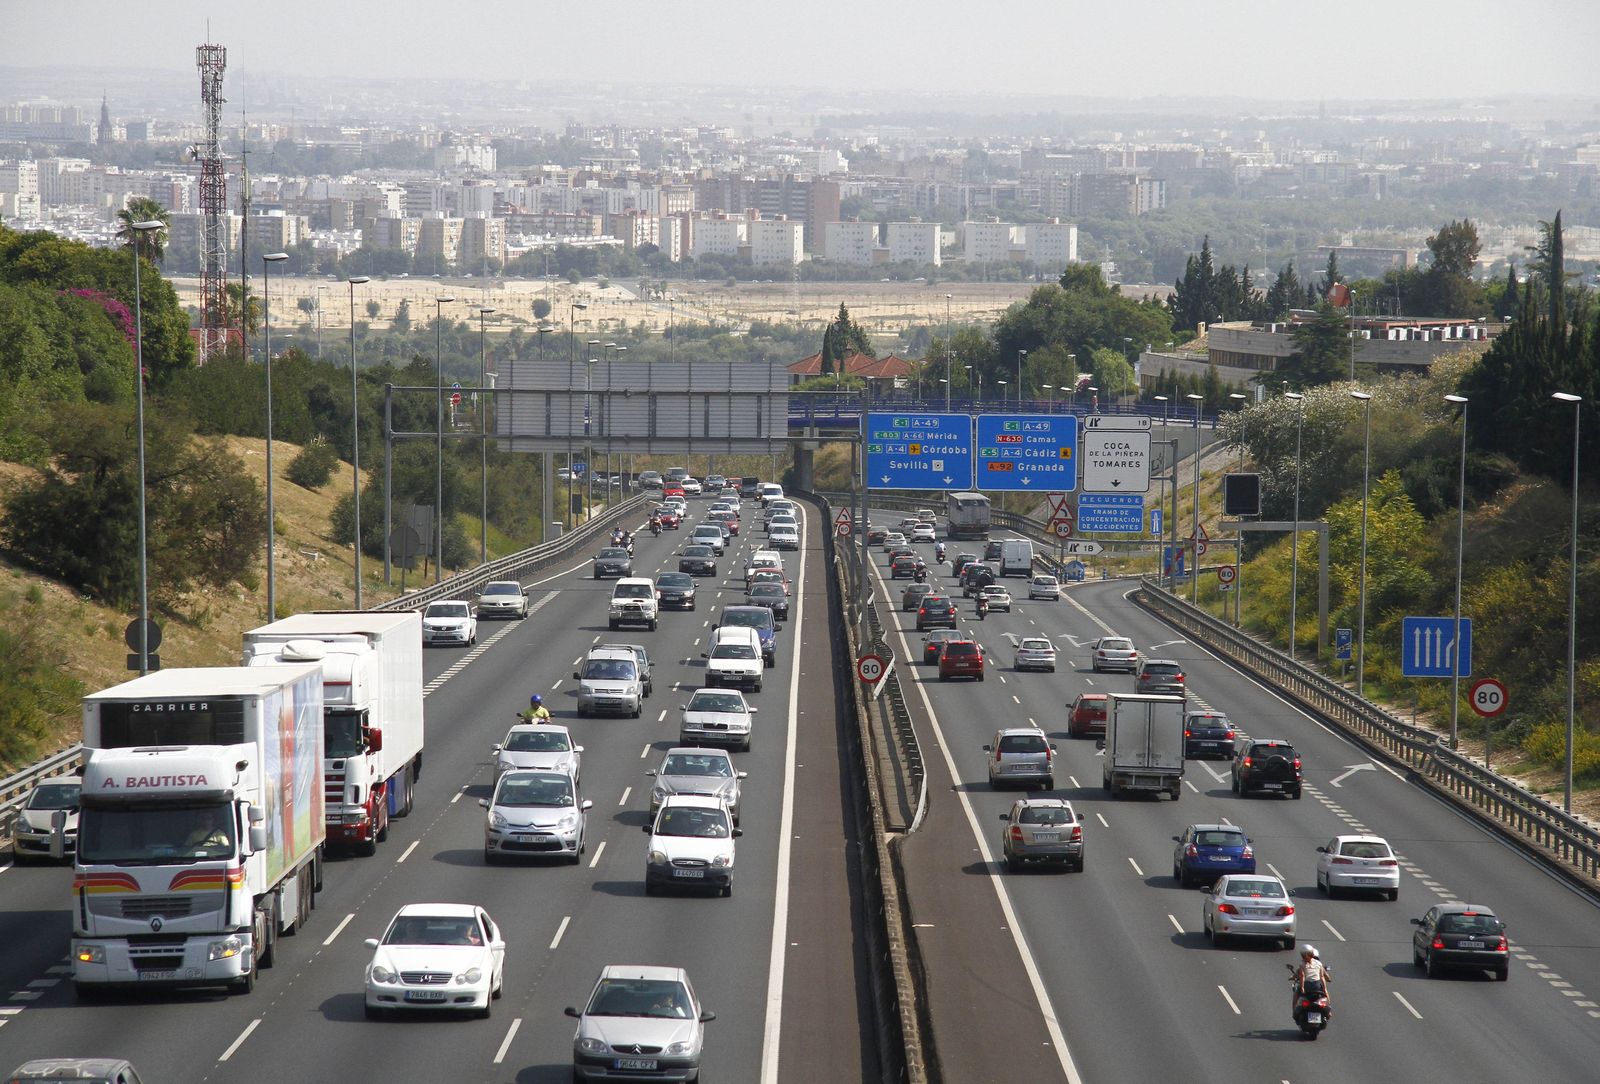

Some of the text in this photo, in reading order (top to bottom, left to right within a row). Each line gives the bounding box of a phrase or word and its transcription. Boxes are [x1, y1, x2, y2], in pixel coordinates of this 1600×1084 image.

[913, 419, 939, 427] A-49
[927, 432, 958, 440] Mérida
[887, 445, 905, 453] A-4
[922, 445, 967, 454] Córdoba
[1103, 442, 1130, 450] COCA
[1025, 448, 1057, 457] Cádiz
[889, 460, 928, 469] Sevilla
[988, 462, 1064, 471] A-92 Granada
[1093, 460, 1140, 468] TOMARES
[863, 664, 879, 674] 80
[1477, 691, 1500, 704] 80
[133, 702, 208, 712] CARRIER
[102, 774, 208, 788] A. BAUTISTA
